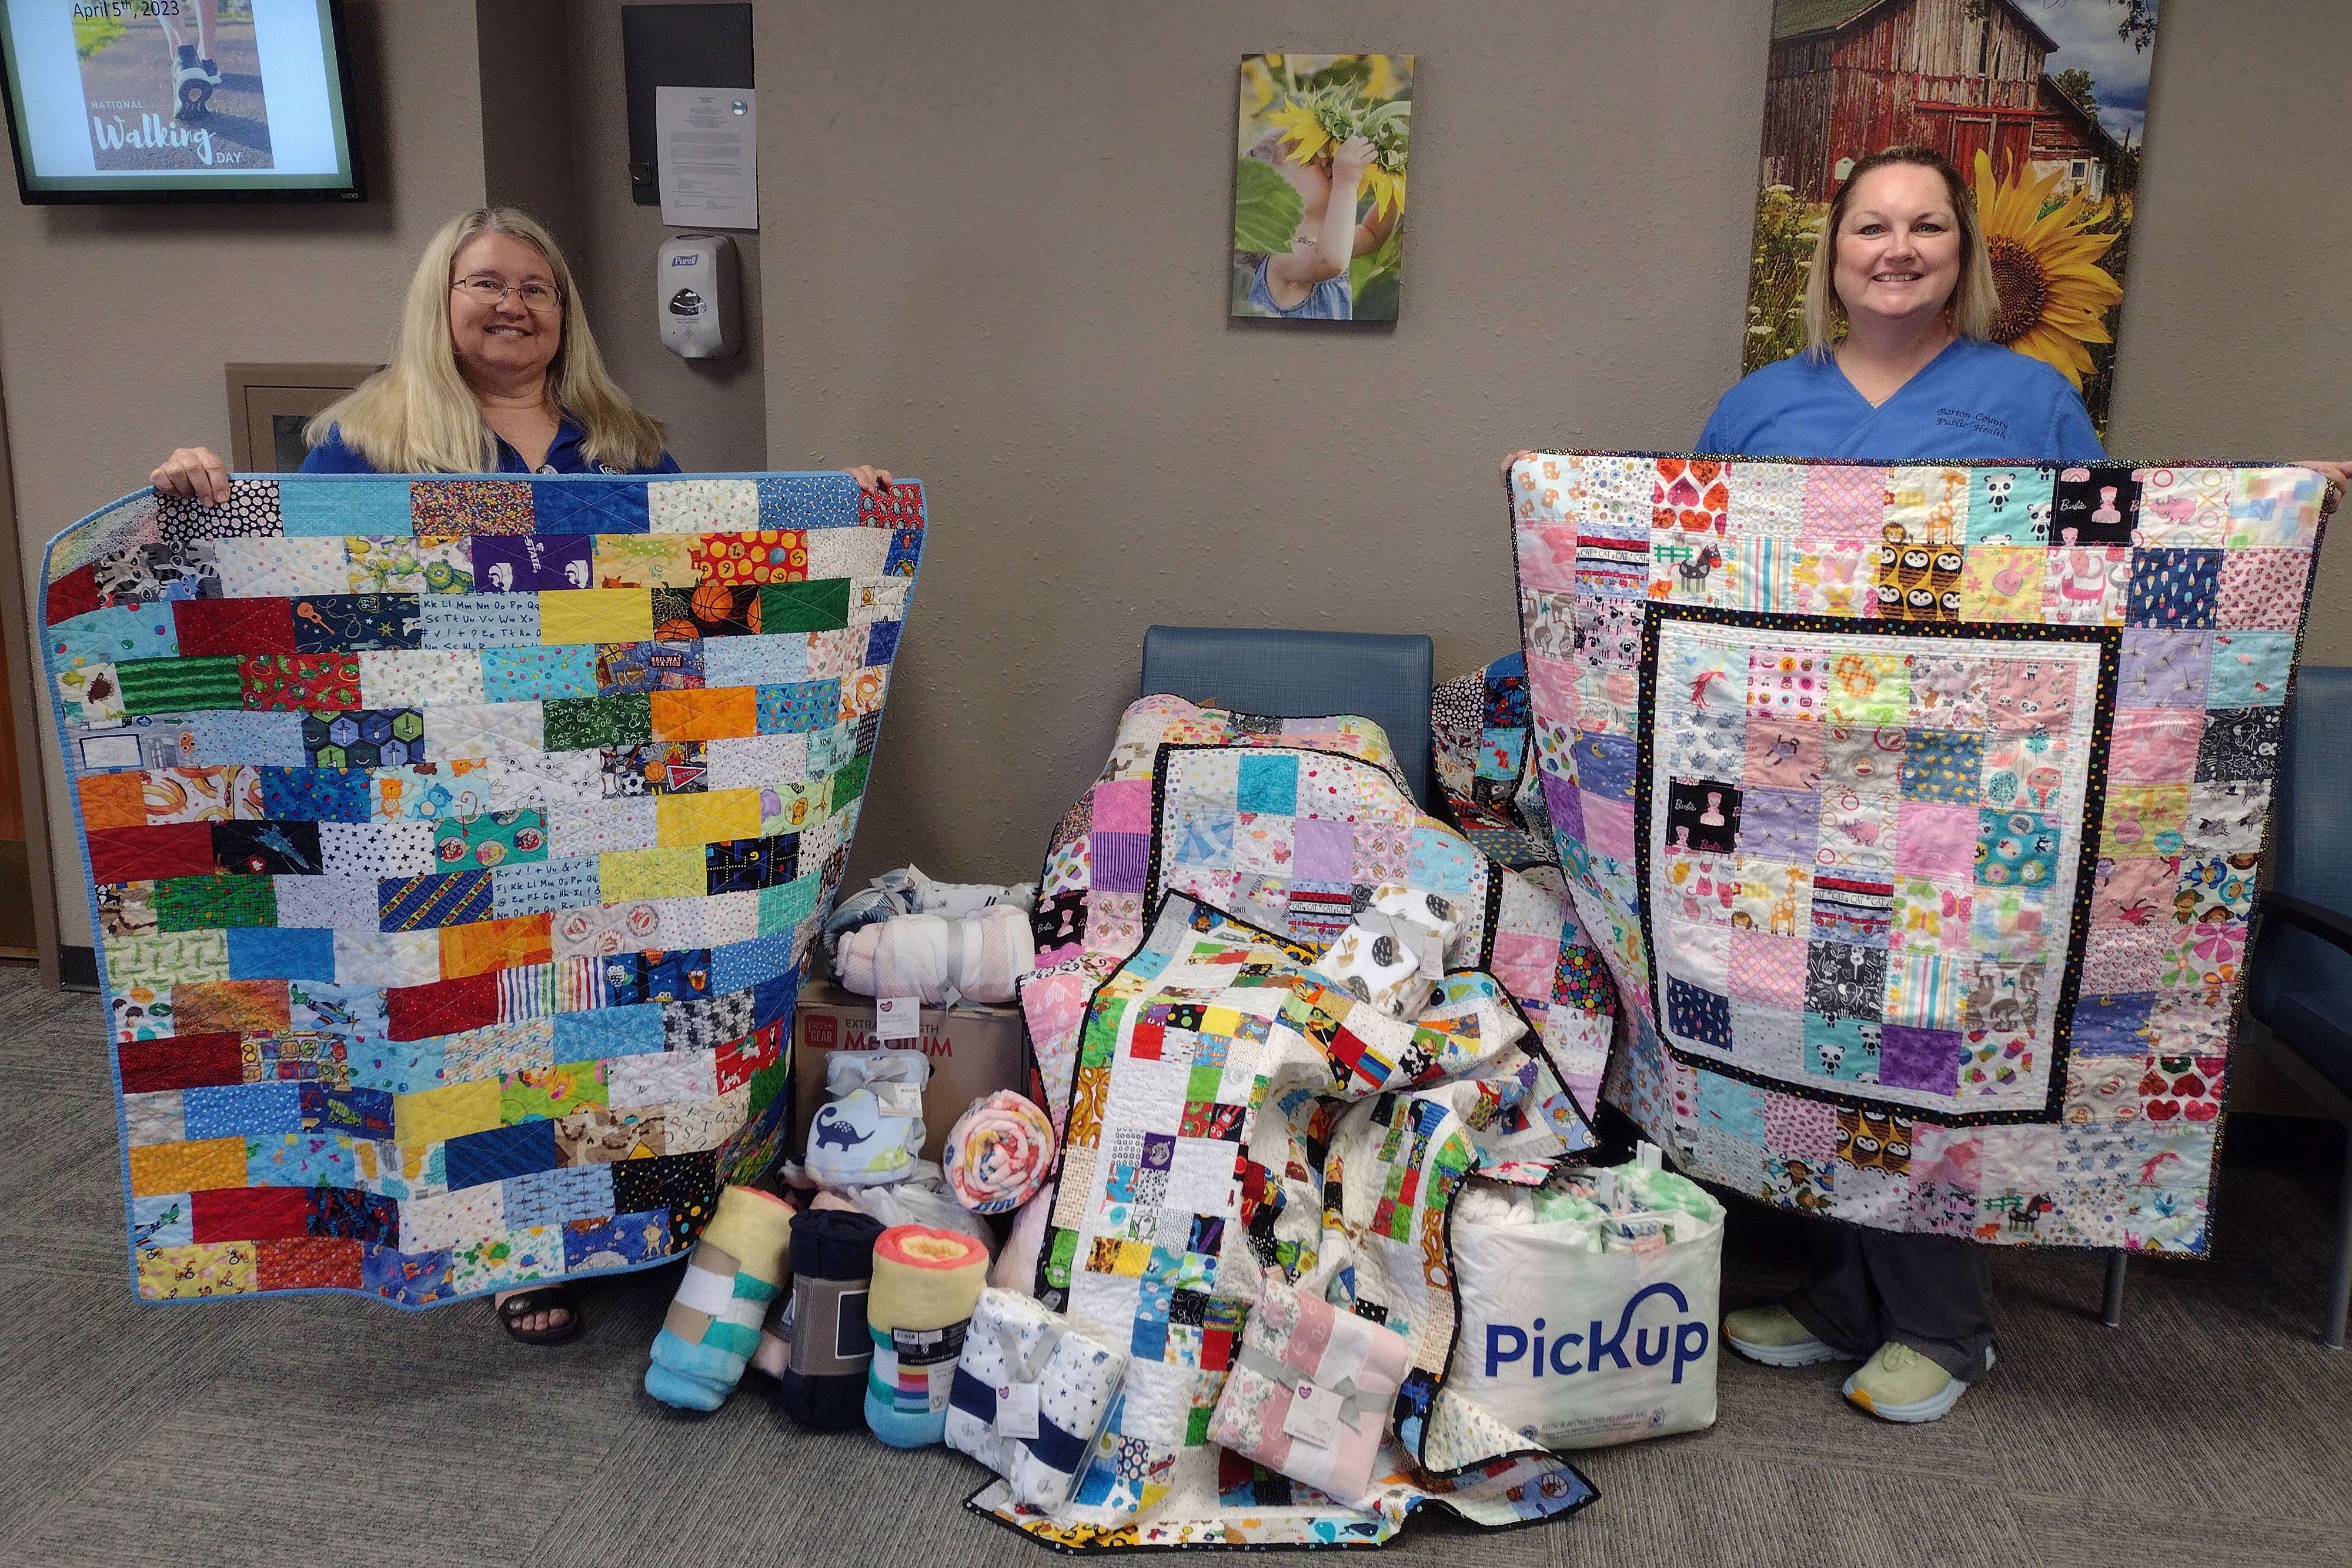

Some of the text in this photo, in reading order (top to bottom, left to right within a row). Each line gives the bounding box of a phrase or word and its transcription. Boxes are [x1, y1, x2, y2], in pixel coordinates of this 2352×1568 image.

[74, 1, 109, 21] April
[141, 1, 179, 16] 2023
[93, 113, 216, 166] Walking
[216, 152, 242, 165] DAY
[674, 256, 696, 265] Purell
[1937, 409, 2009, 430] Barton County
[1936, 418, 2006, 439] Public Health
[2060, 499, 2087, 511] Barbie
[1581, 549, 1593, 557] CAT
[1616, 552, 1628, 560] CAT
[510, 601, 523, 610] Pp
[426, 615, 439, 623] Ss
[499, 615, 515, 623] Ww
[482, 630, 495, 638] Ee
[612, 697, 631, 709] ABC
[554, 715, 573, 730] ABC
[594, 717, 613, 730] DOG
[552, 732, 570, 740] CAT
[552, 738, 573, 747] DOG
[1675, 798, 1696, 811] Barbie
[496, 870, 510, 878] Rr
[571, 876, 582, 885] Pp
[559, 889, 569, 897] Hh
[1812, 890, 1826, 898] CAT
[1832, 891, 1845, 902] CAT
[1850, 895, 1865, 904] CAT
[1871, 897, 1886, 907] CAT
[1038, 922, 1054, 934] Barbie
[811, 1030, 832, 1042] GEAR
